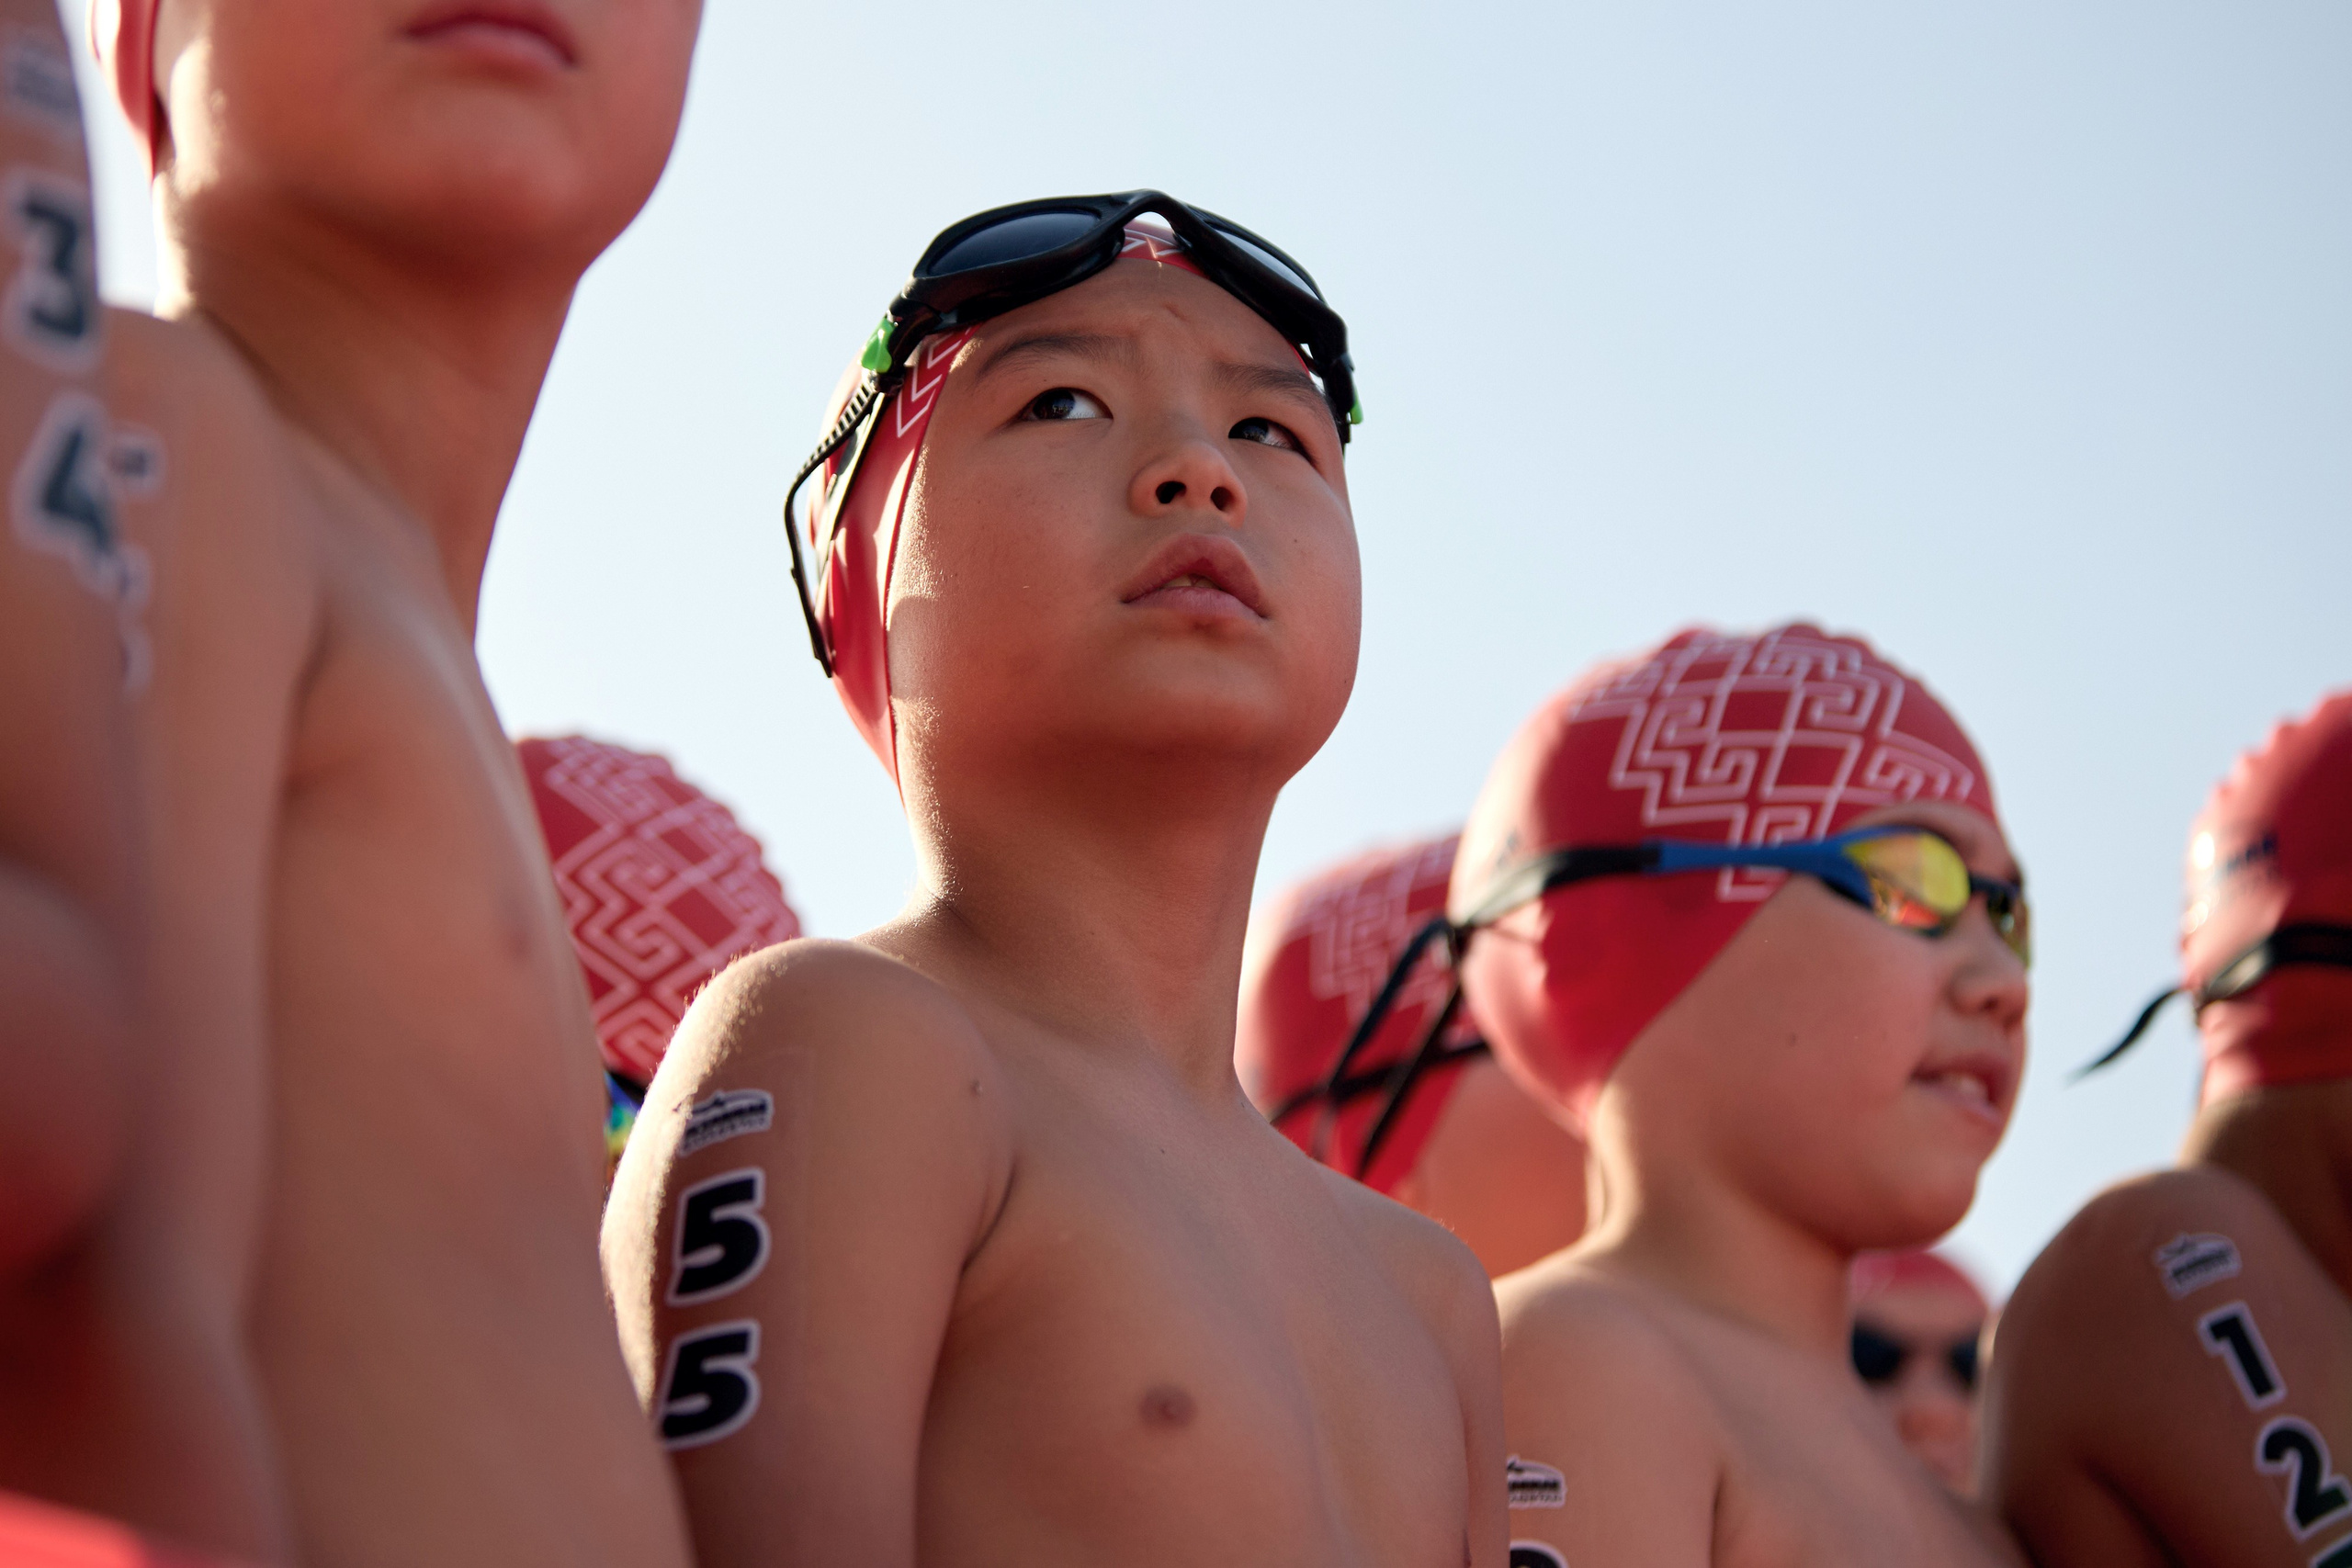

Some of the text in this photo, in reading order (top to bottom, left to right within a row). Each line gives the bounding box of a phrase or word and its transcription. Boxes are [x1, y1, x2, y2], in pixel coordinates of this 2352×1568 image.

[672, 1173, 766, 1301] 5
[659, 1325, 754, 1444] 5
[2204, 1308, 2280, 1404] 1
[2259, 1423, 2351, 1535] 2
